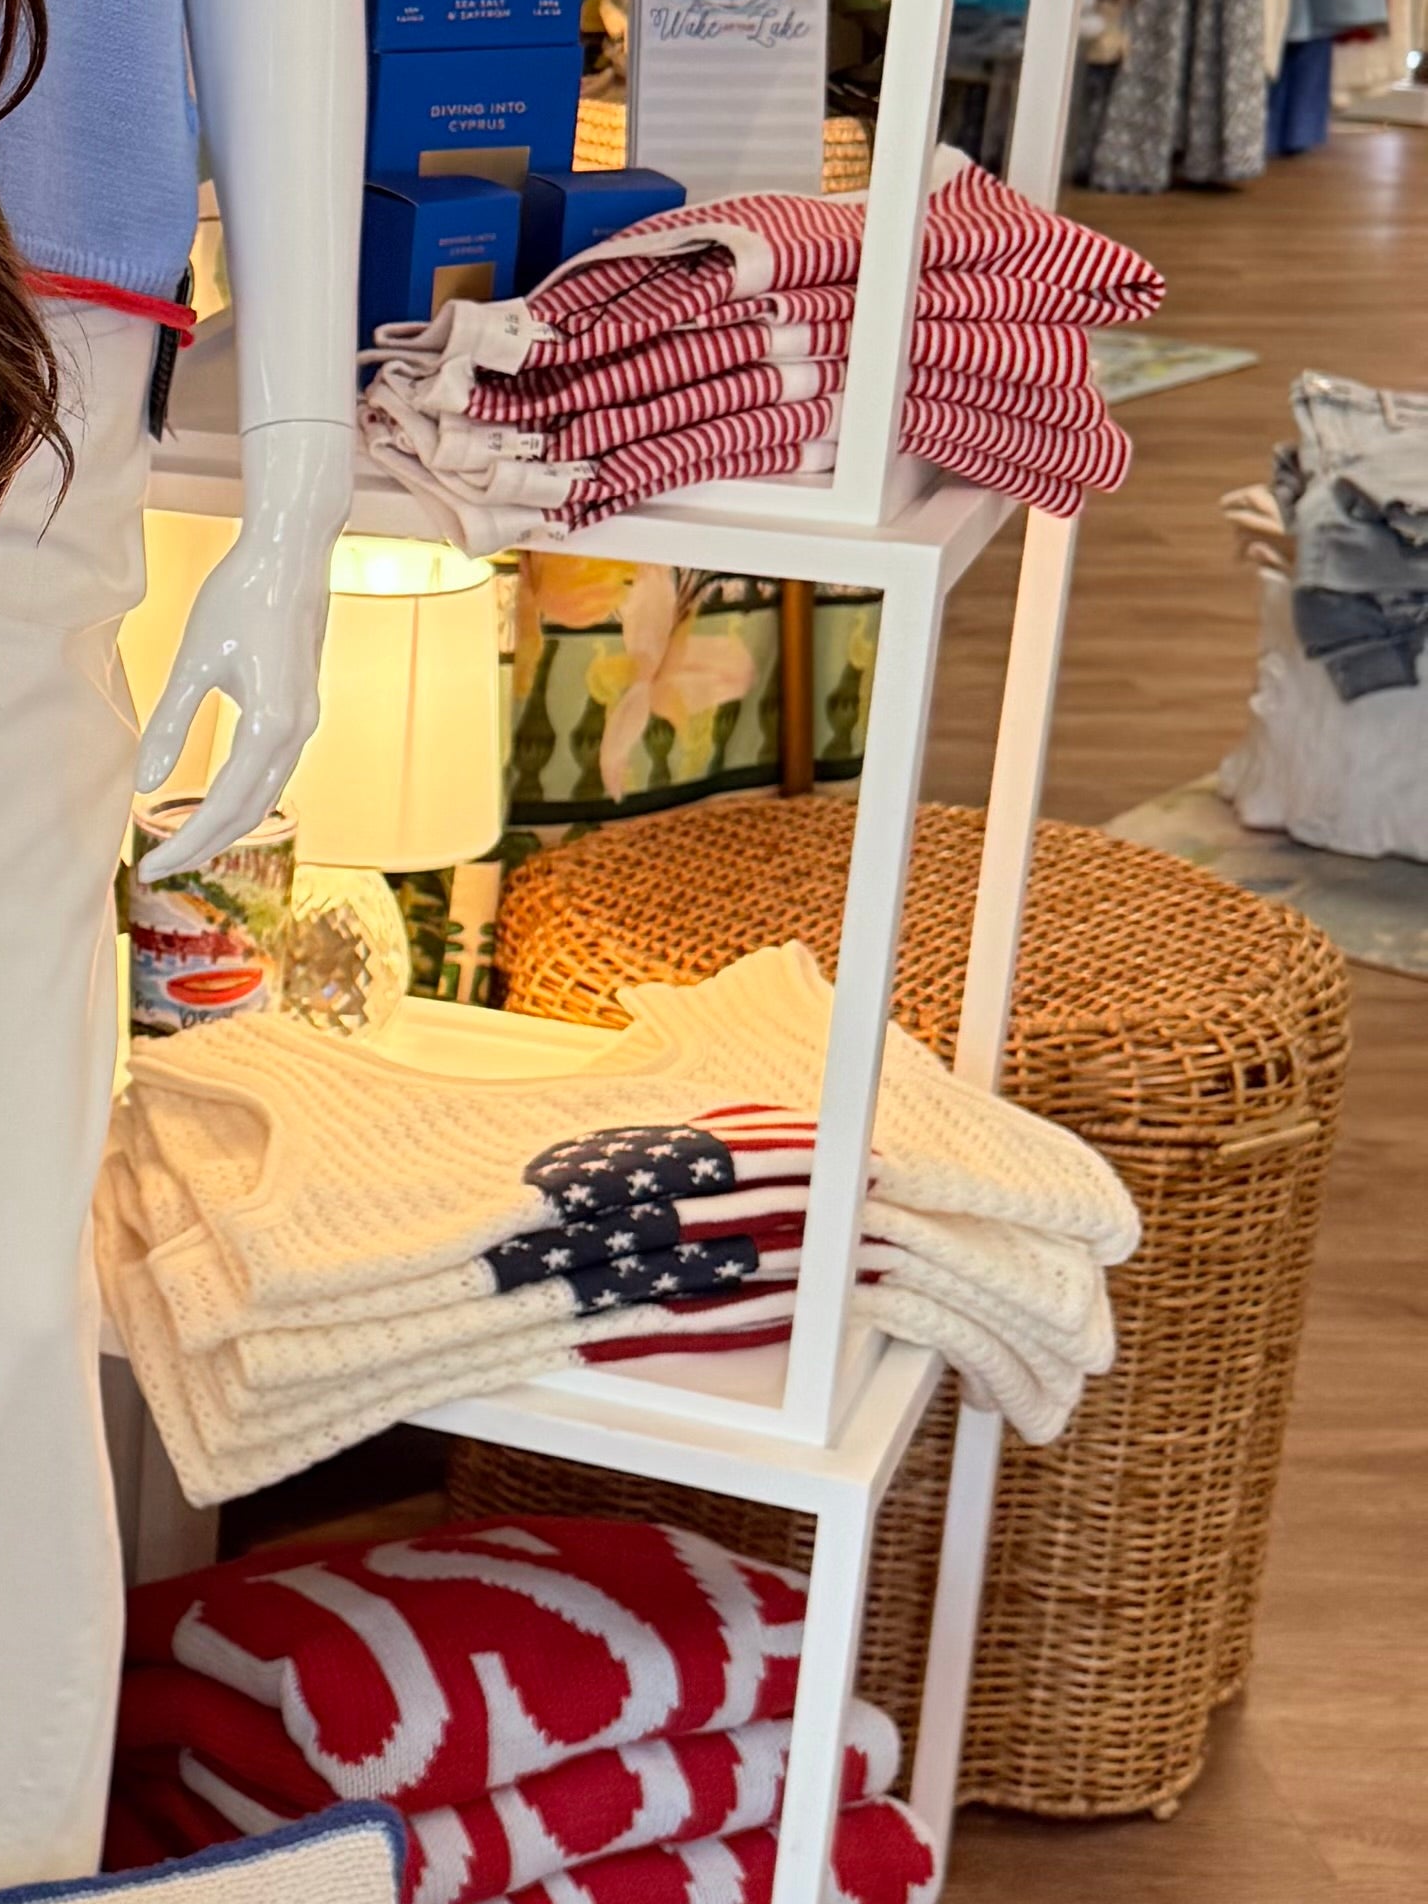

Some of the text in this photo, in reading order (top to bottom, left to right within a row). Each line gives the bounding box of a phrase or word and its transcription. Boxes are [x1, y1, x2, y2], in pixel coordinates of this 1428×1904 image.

[430, 101, 526, 118] DIVING INTO
[448, 118, 505, 133] CYPRUS
